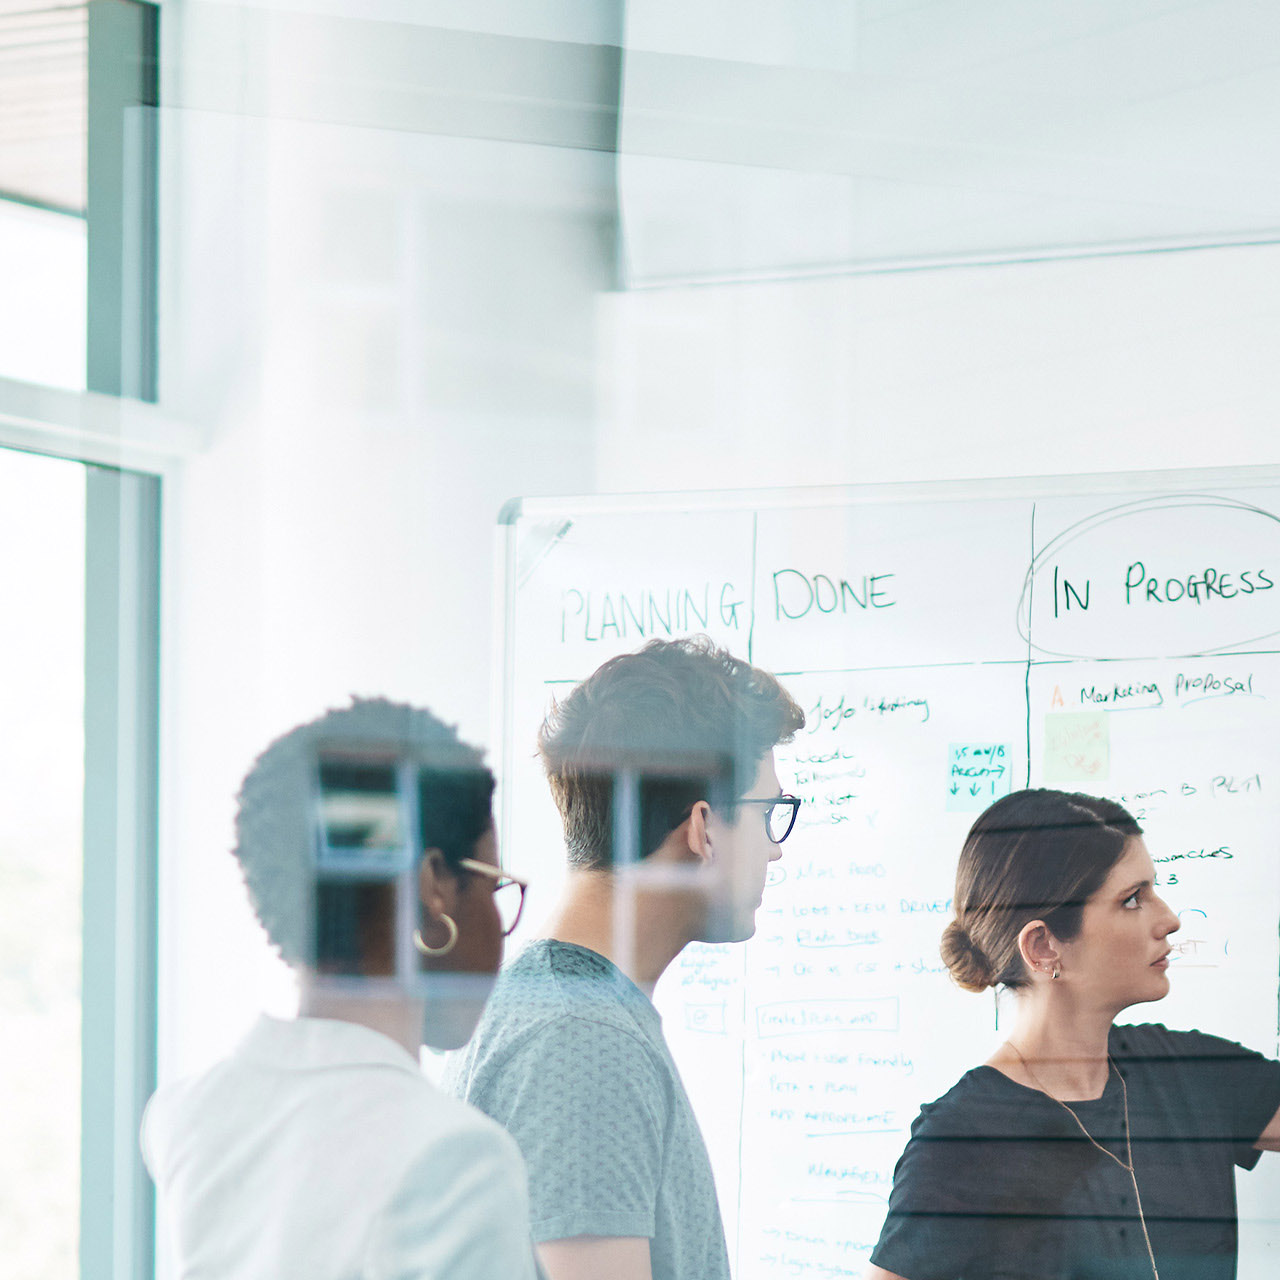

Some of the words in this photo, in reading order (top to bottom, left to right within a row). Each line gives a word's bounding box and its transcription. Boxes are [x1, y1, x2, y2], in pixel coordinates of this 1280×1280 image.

[561, 582, 744, 642] PLANNING
[773, 568, 898, 621] DONE
[1054, 565, 1091, 618] IN
[1125, 561, 1275, 605] PROGRESS
